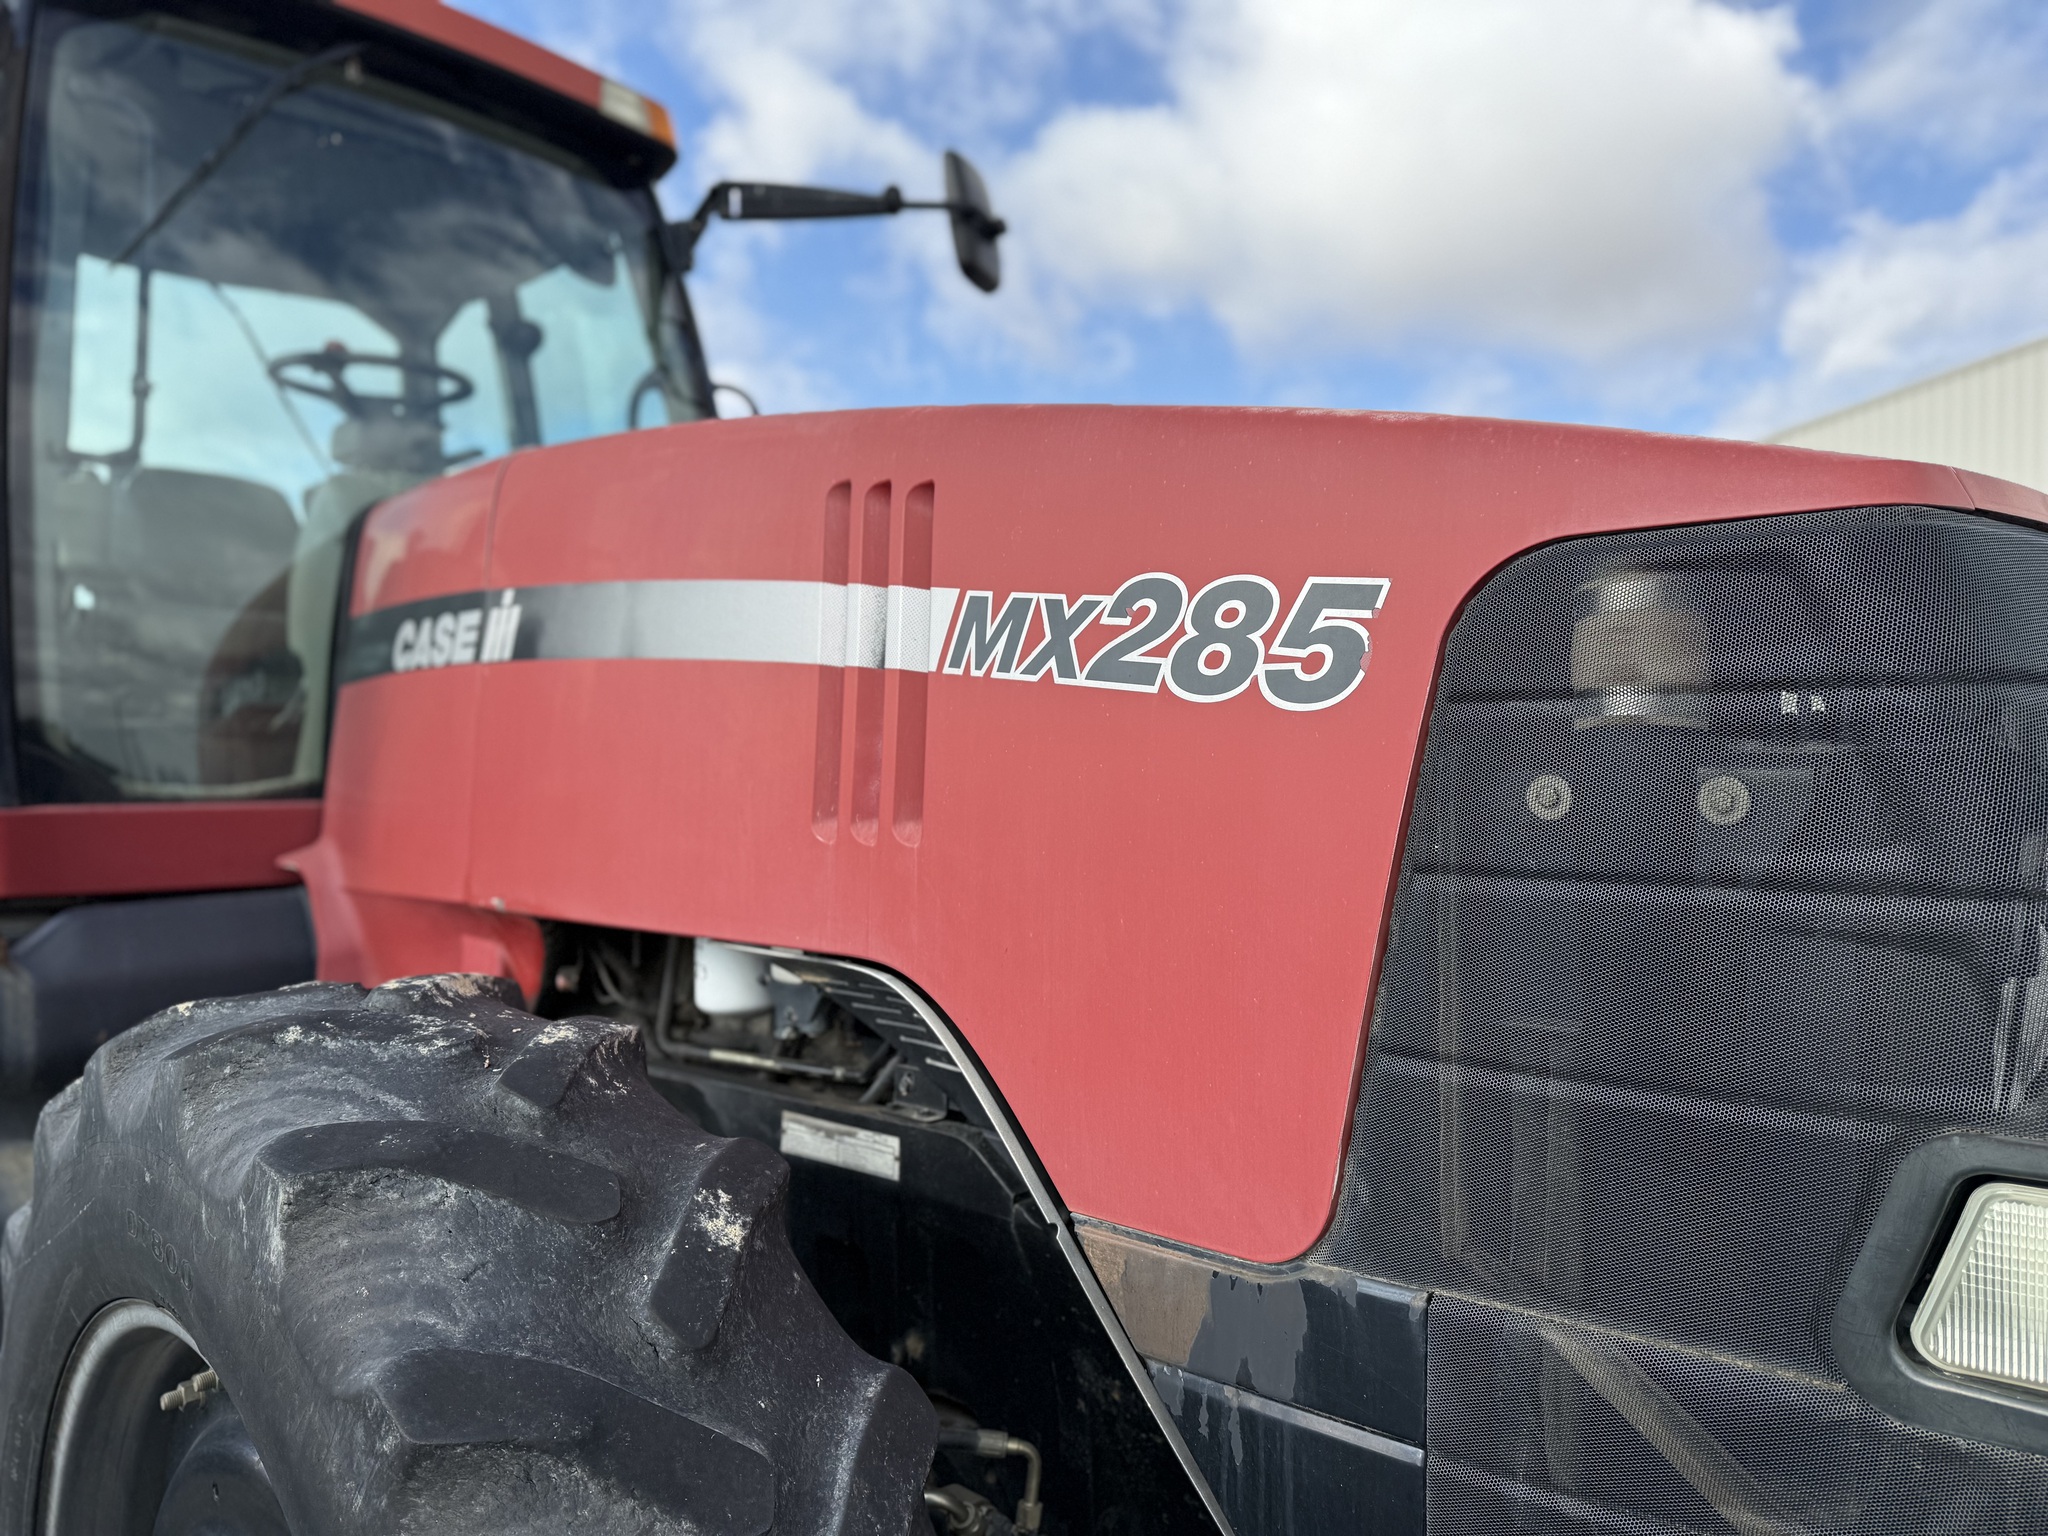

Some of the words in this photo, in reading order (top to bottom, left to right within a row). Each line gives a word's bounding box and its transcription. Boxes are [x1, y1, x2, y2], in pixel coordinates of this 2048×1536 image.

[391, 608, 483, 673] CASE
[943, 572, 1391, 712] MX285
[126, 1208, 193, 1291] DT800
